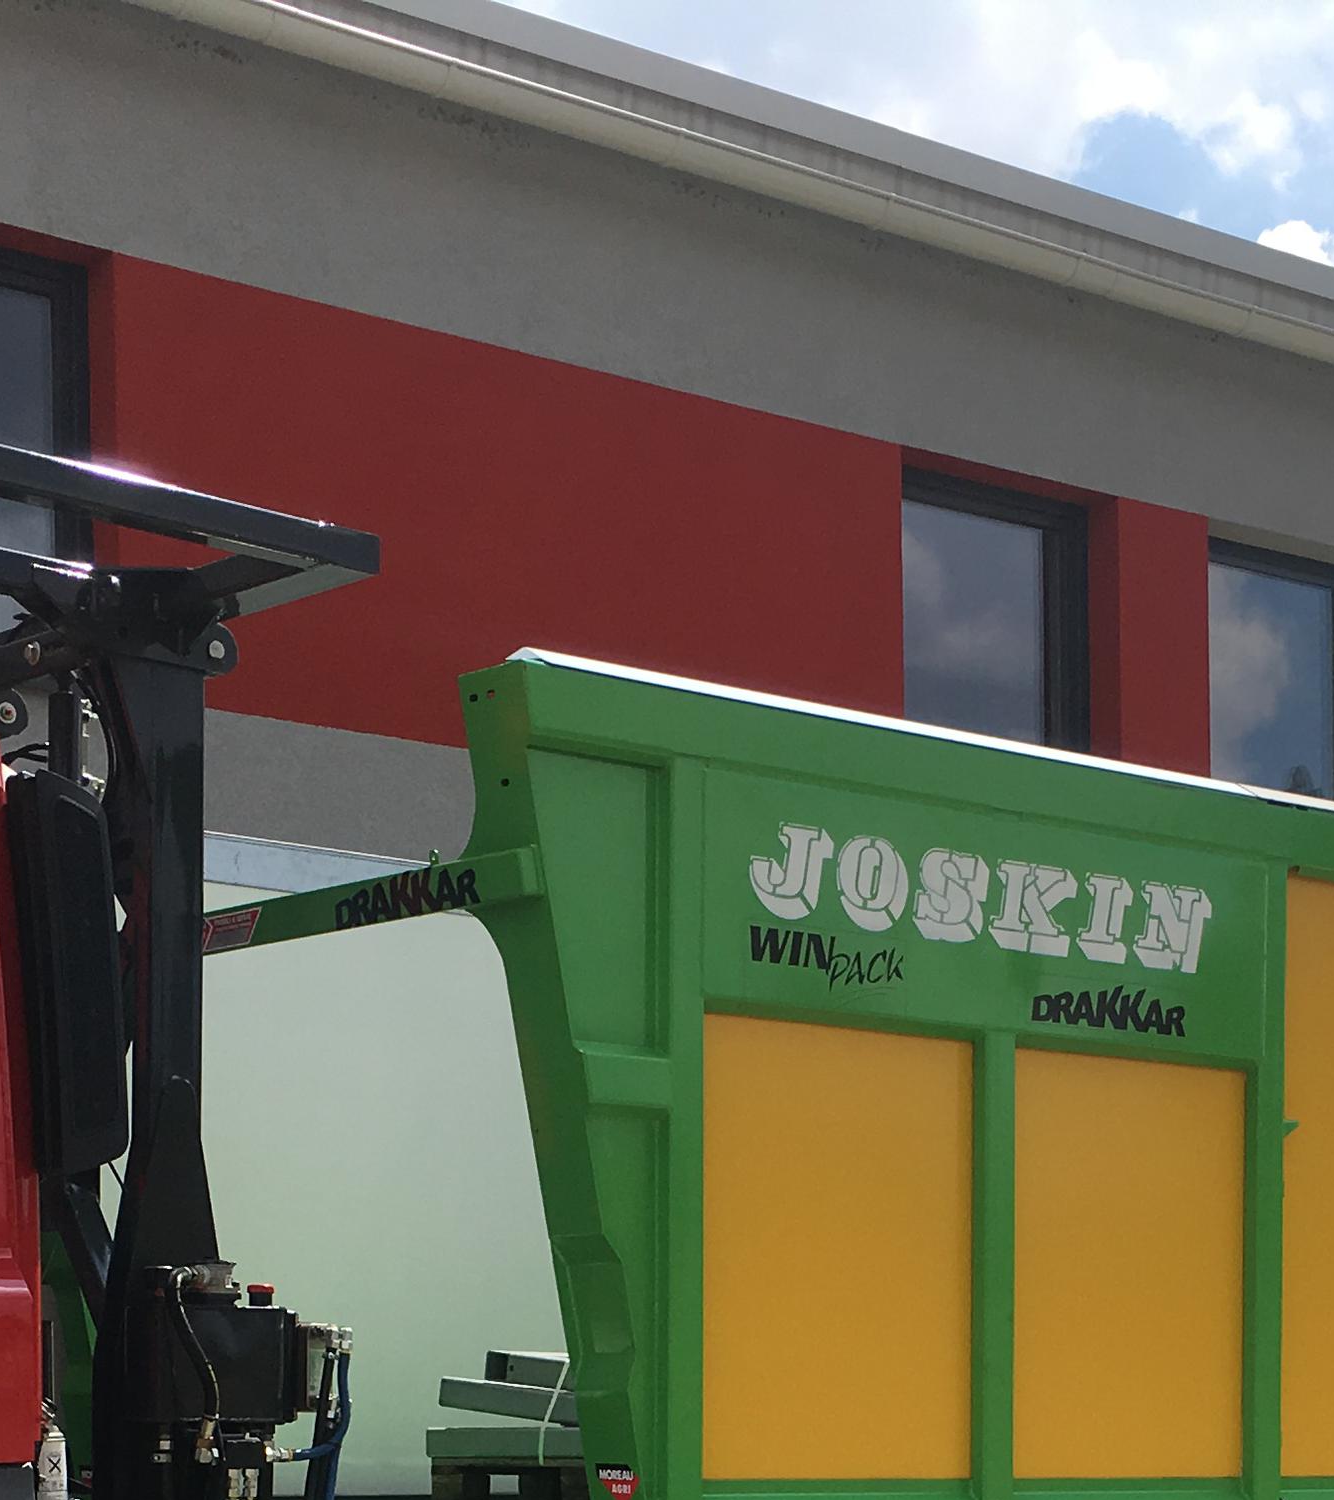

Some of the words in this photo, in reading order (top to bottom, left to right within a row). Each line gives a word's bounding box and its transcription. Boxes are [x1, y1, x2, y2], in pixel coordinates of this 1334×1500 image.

[335, 866, 481, 930] DRAKKAR
[749, 821, 1212, 974] JOSKIN
[1031, 985, 1186, 1037] DRAKKAR
[598, 1469, 635, 1481] MOREAU
[611, 1483, 632, 1495] AGRI
